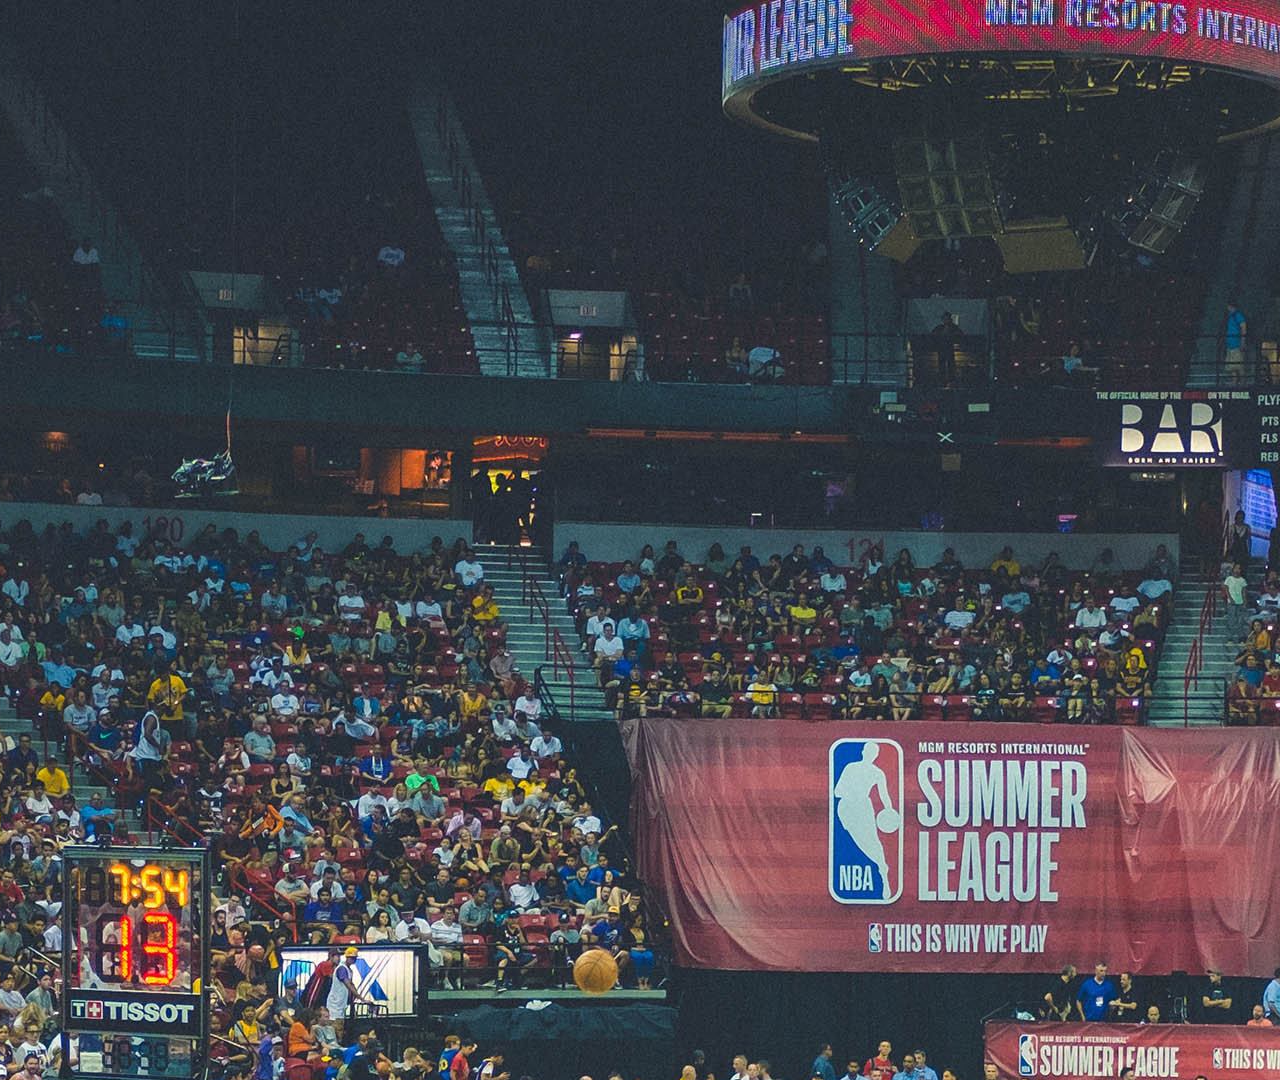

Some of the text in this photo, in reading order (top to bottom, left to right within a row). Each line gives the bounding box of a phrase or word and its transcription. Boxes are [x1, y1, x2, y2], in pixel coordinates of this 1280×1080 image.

[1065, 0, 1187, 35] RESORTS
[760, 0, 848, 70] LEAGUE
[1096, 392, 1108, 400] THE
[1262, 415, 1279, 427] PTS
[1261, 433, 1279, 444] FLS
[1261, 451, 1279, 463] REB
[918, 743, 1087, 756] MGM RESORTS INTERNATIONAL
[918, 760, 1087, 828] SUMMER
[838, 865, 874, 892] NBA
[919, 831, 1060, 902] LEAGUE
[110, 863, 188, 908] 7:54
[120, 912, 177, 985] 13
[885, 924, 1048, 953] THIS IS WHY WE PLAY
[102, 1002, 194, 1023] TISSOT
[1040, 1046, 1179, 1077] SUMMER LEAGUE
[1225, 1047, 1251, 1069] THIS
[1253, 1048, 1265, 1069] IS
